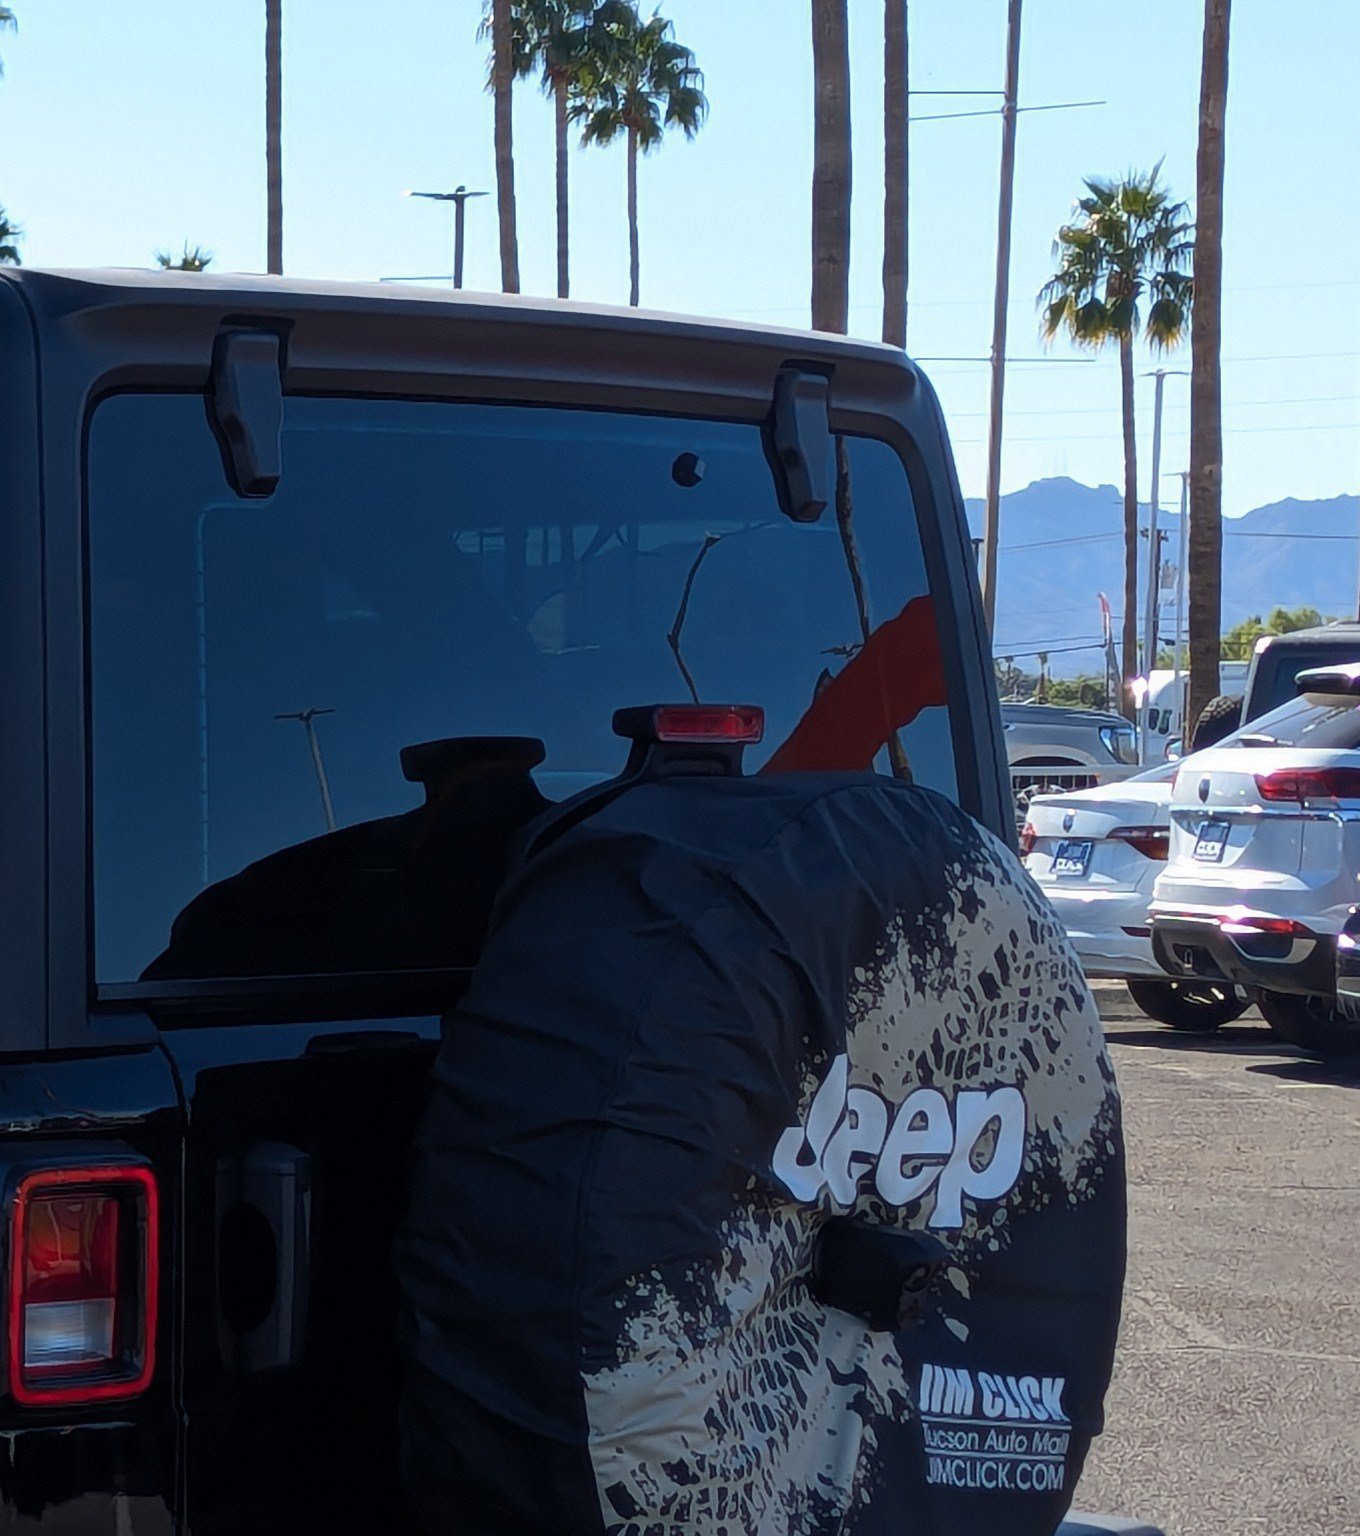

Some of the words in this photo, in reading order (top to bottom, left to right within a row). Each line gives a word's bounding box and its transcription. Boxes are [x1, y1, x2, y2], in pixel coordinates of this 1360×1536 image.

[771, 1053, 1026, 1228] Jeep
[977, 1371, 1071, 1422] CLICK
[922, 1423, 979, 1450] Tucson
[984, 1429, 1028, 1452] Auto
[1032, 1431, 1070, 1454] Mall
[926, 1457, 1065, 1491] JIMCLICK.COM
